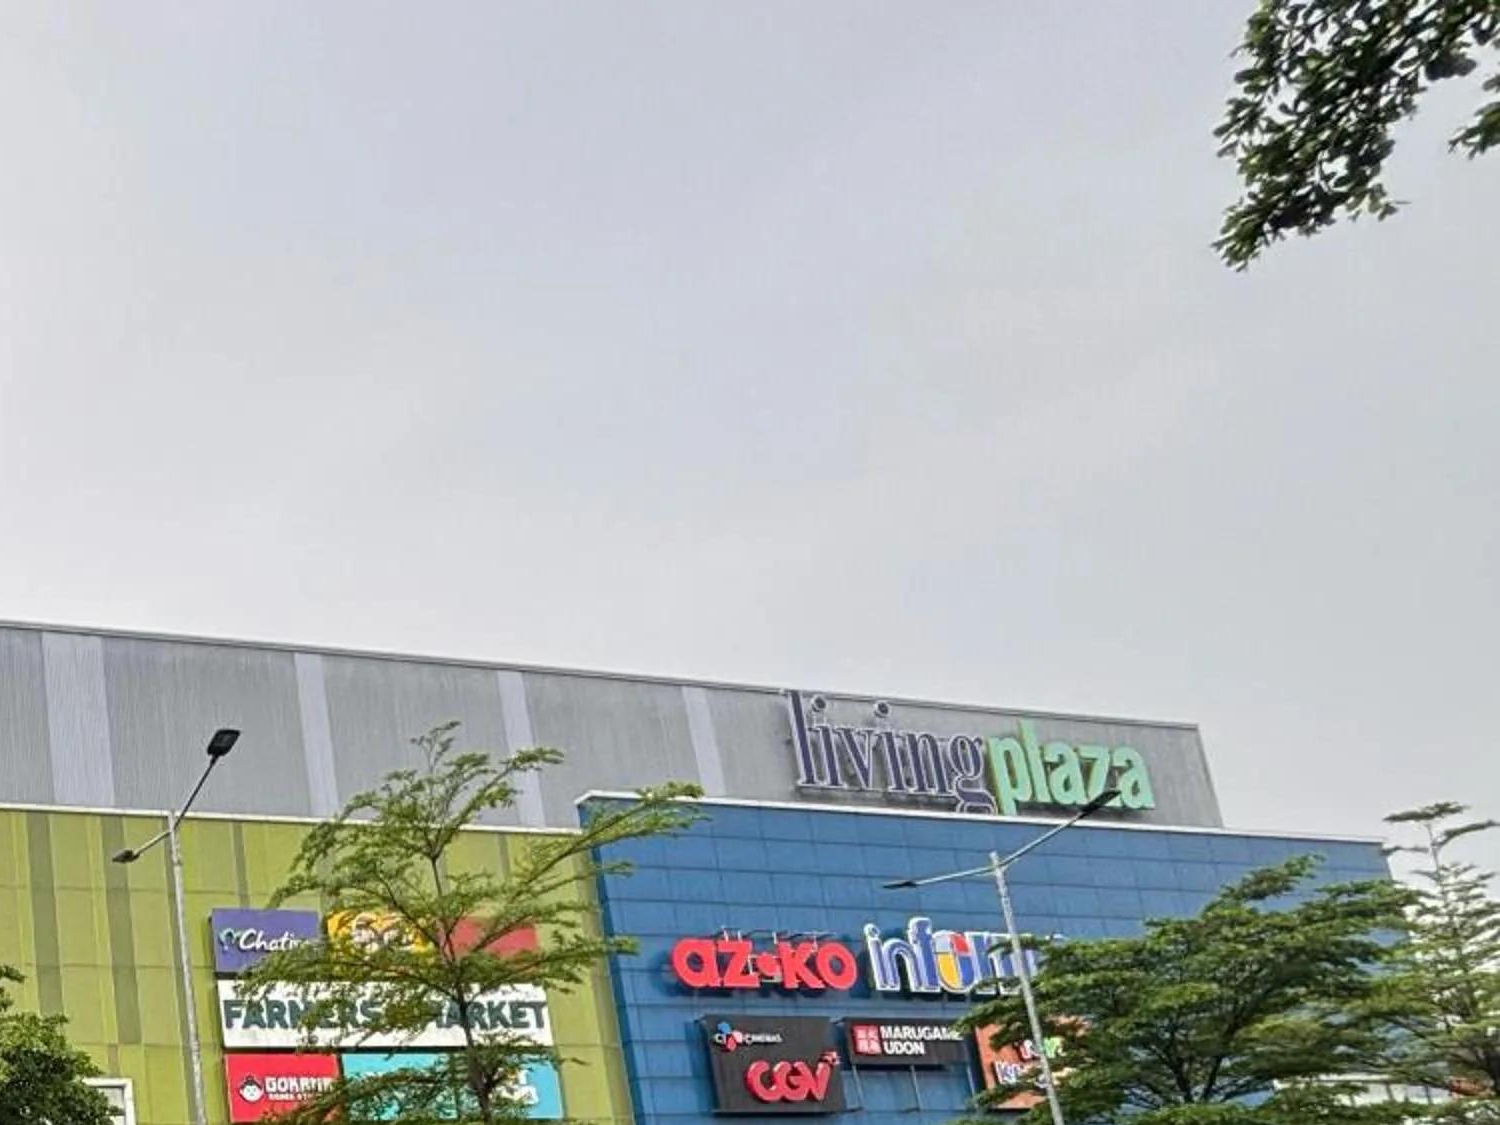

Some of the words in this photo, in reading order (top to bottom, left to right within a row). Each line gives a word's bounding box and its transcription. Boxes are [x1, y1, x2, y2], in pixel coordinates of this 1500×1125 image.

[783, 689, 998, 815] living
[987, 719, 1156, 816] plaza
[883, 1041, 925, 1055] UDON
[745, 1060, 832, 1102] CGV
